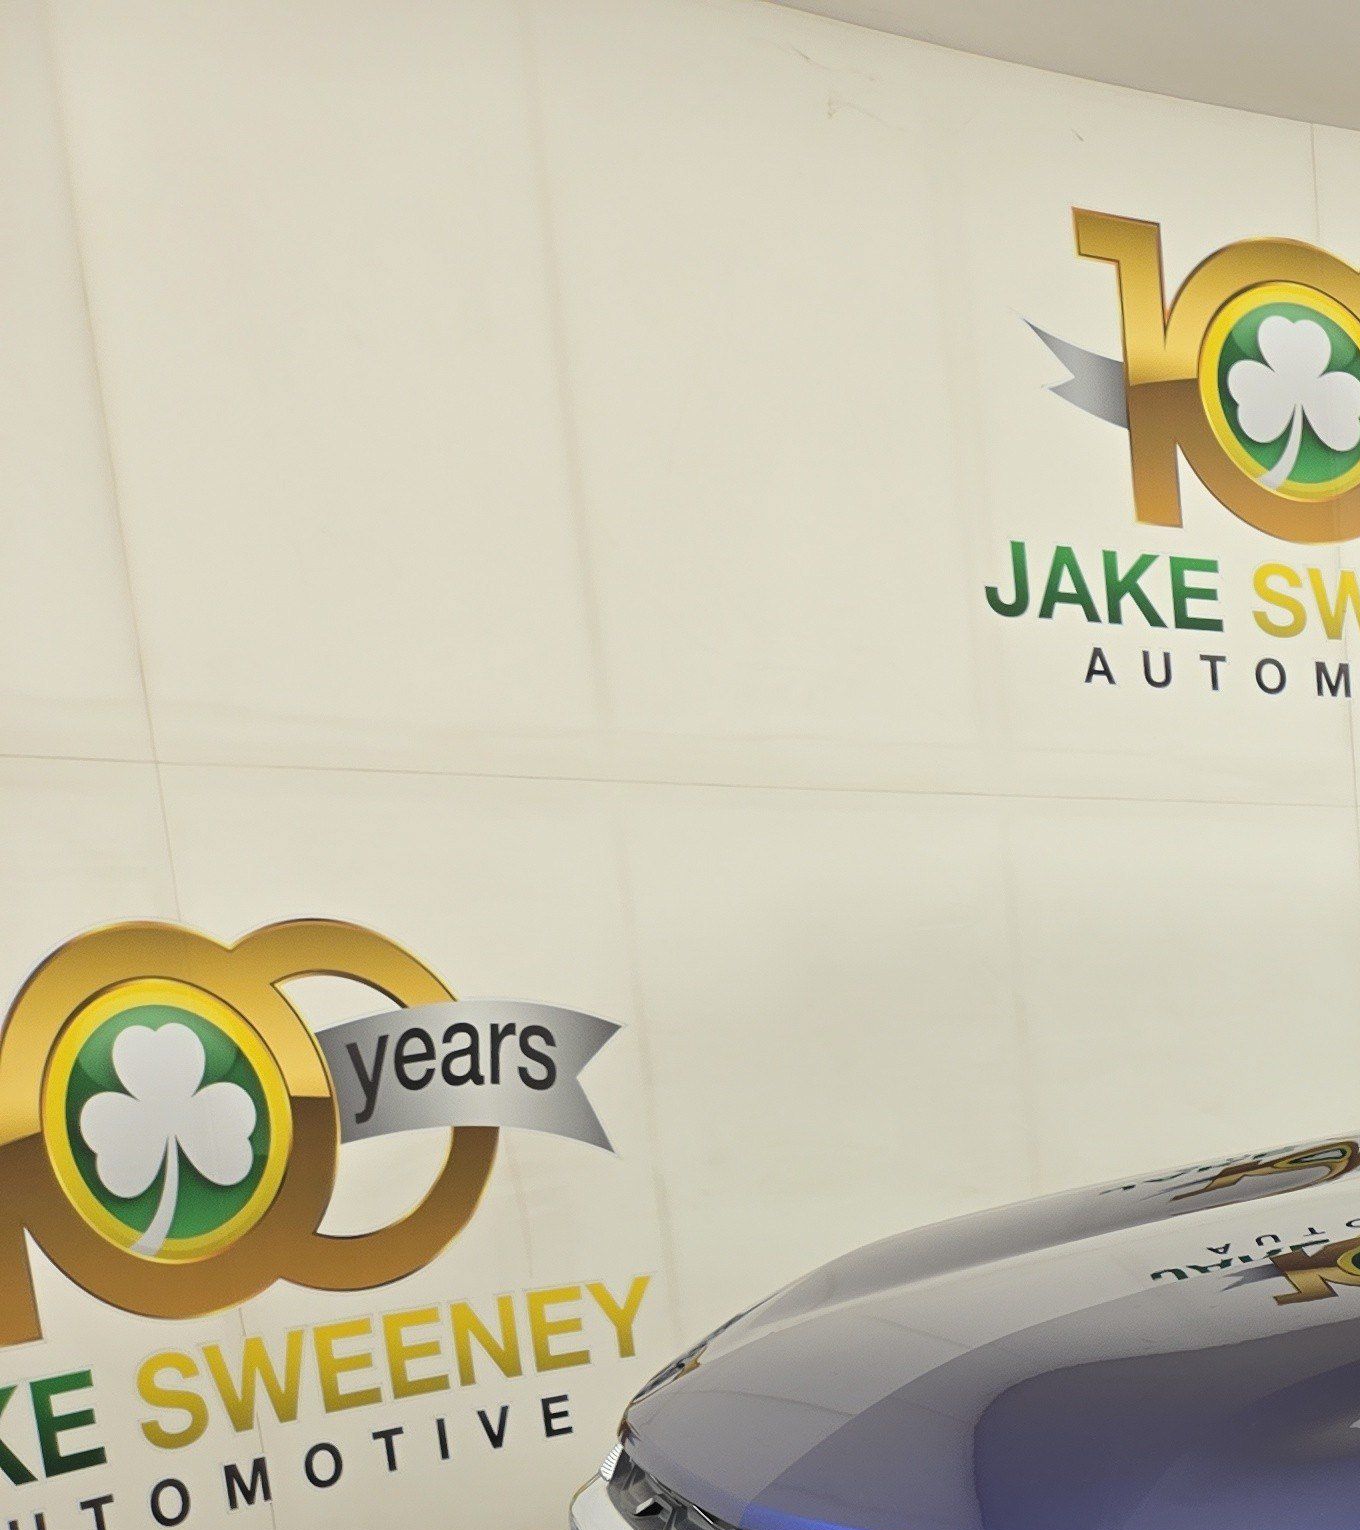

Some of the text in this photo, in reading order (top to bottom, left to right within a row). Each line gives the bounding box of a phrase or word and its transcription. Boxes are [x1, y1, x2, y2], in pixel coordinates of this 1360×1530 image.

[985, 540, 1224, 633] JAKE
[345, 1021, 558, 1123] years
[135, 1275, 651, 1449] SWEENEY
